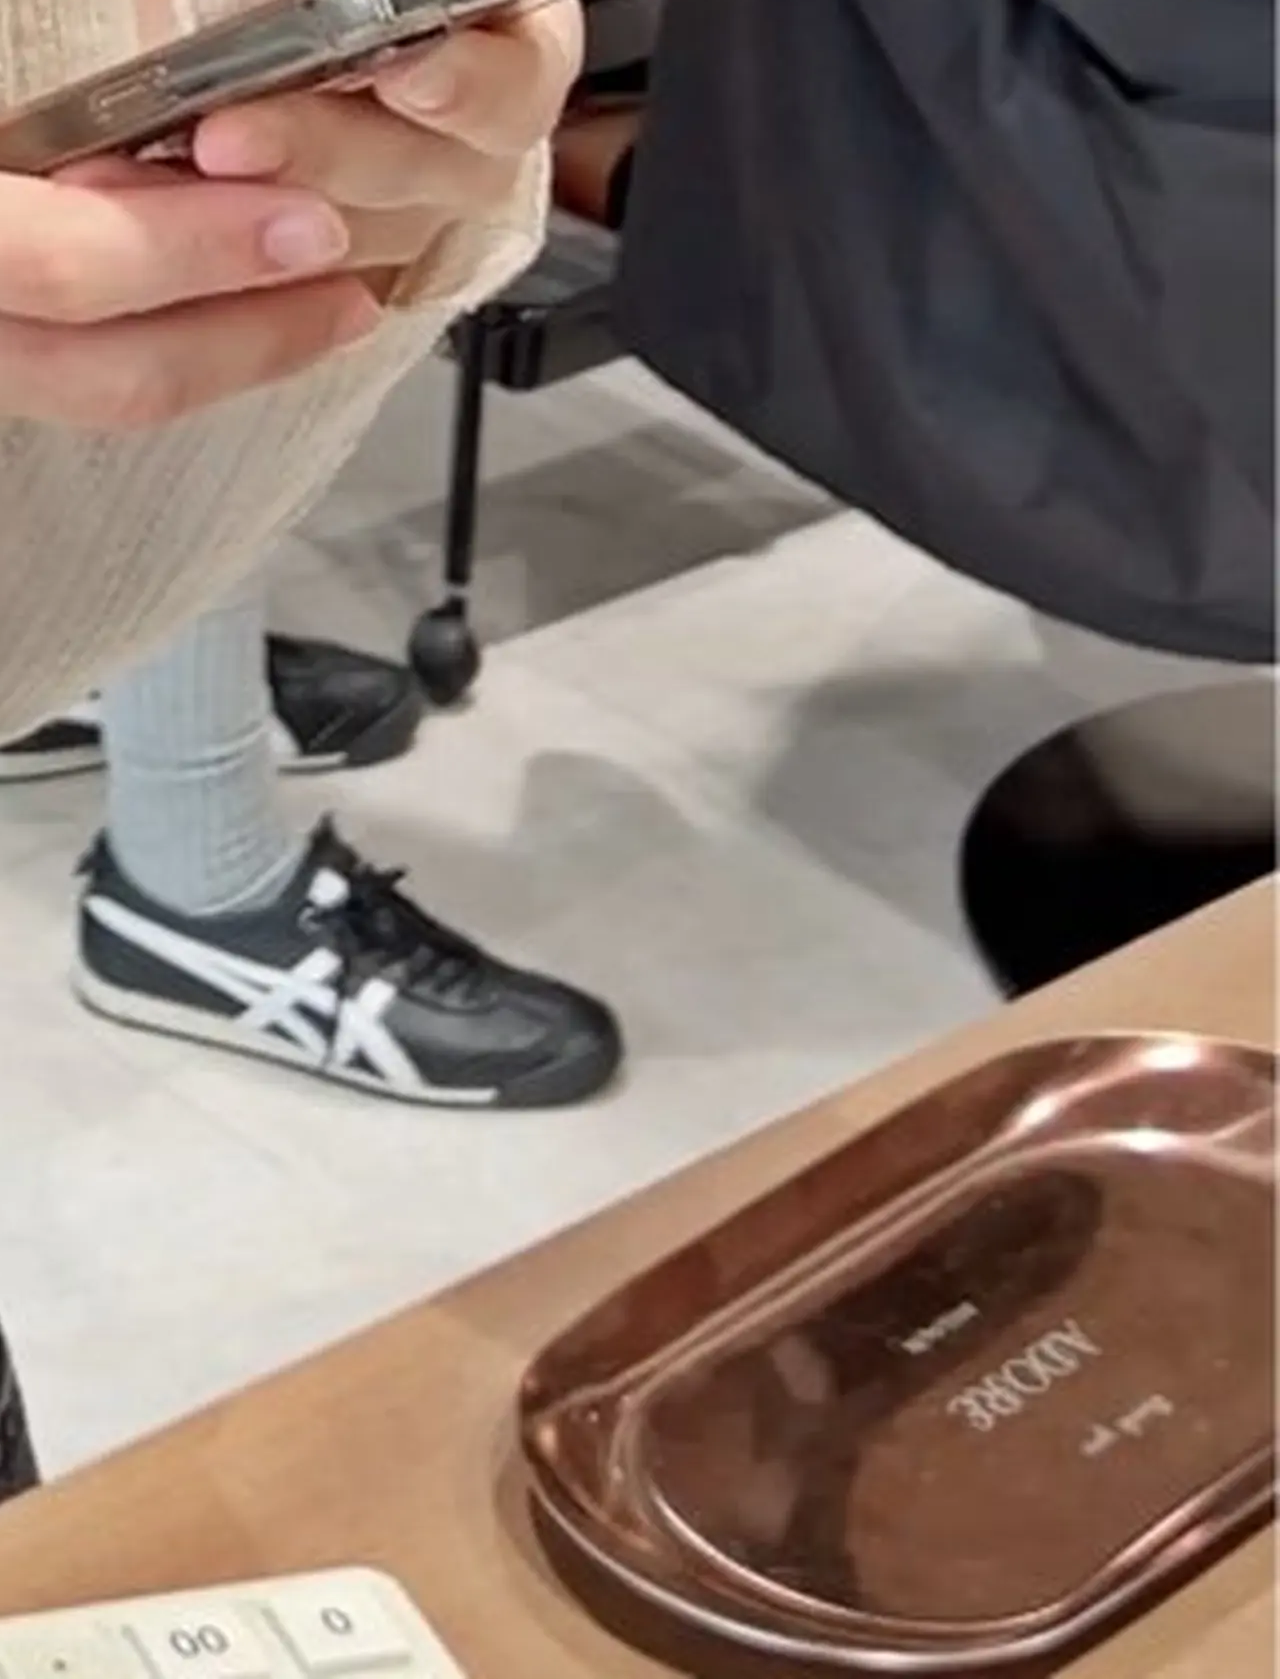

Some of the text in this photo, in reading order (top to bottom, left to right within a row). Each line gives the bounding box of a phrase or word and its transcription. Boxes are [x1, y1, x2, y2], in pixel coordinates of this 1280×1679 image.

[947, 1318, 1102, 1432] ADORE
[320, 1607, 354, 1635] 0
[168, 1624, 230, 1659] 00
